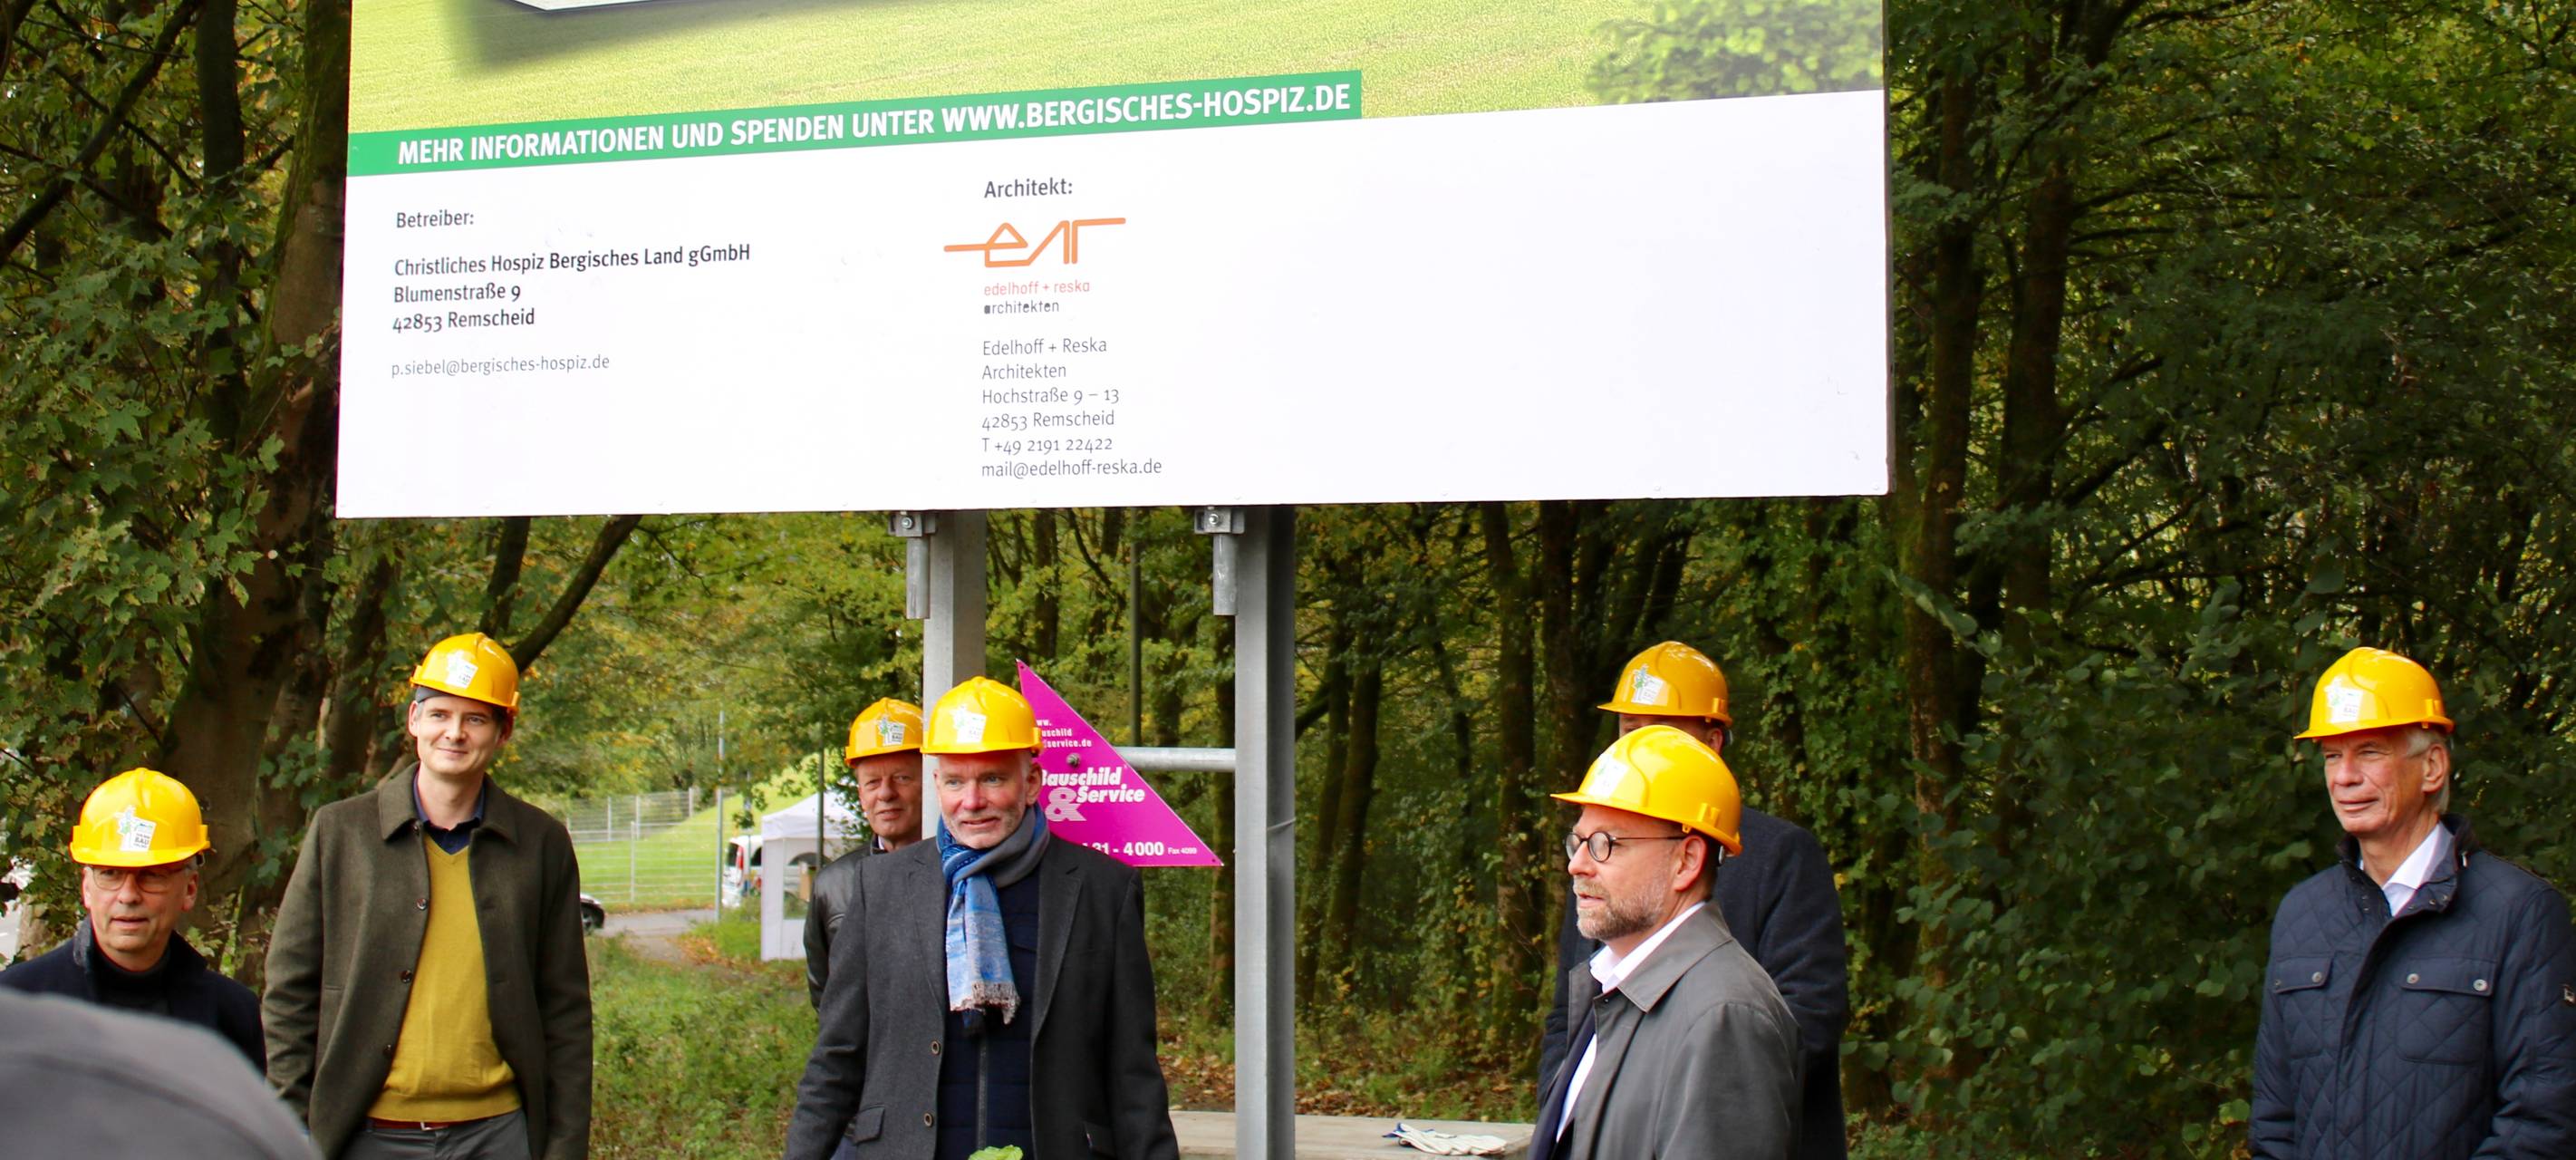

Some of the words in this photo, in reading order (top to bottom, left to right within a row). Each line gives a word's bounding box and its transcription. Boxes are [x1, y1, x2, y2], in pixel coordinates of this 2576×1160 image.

[398, 138, 465, 166] MEHR
[469, 124, 665, 161] INFORMATIONEN
[671, 121, 724, 150] UND
[730, 114, 844, 147] SPENDEN
[852, 108, 935, 139] UNTER
[941, 82, 1351, 133] WWW.BERGISCHES-HOSPIZ.DE
[983, 176, 1074, 199] Architekt:
[395, 208, 475, 229] Betreiber:
[393, 256, 487, 277] Christliches
[490, 252, 545, 276] Hospiz
[549, 248, 640, 274] Bergisches
[643, 245, 684, 266] Land
[687, 242, 752, 268] gGmbH
[392, 281, 507, 304] Blumenstraße
[509, 284, 523, 304] 9
[983, 280, 1040, 296] edelhoff
[1042, 283, 1050, 292] +
[1053, 278, 1091, 294] reska
[983, 298, 1060, 315] architekten
[391, 312, 444, 335] 42853
[447, 306, 536, 330] Remscheid
[982, 337, 1046, 357] Edelhoff
[1048, 343, 1058, 353] +
[1062, 335, 1108, 354] Reska
[391, 353, 611, 380] p.siebel@bergisches-hospiz.de
[980, 362, 1067, 381] Architekten
[982, 386, 1069, 405] Hochstraße
[1073, 390, 1085, 407] 9
[1103, 389, 1120, 404] 13
[981, 412, 1028, 433] 42853
[1033, 409, 1115, 429] Remscheid
[981, 437, 991, 453] T
[993, 439, 1023, 457] +49
[1027, 440, 1061, 456] 2191
[1065, 437, 1114, 455] 22422
[980, 457, 1163, 480] mail@edelhoff-reska.de
[1044, 787, 1087, 822] &
[1076, 783, 1146, 804] Service
